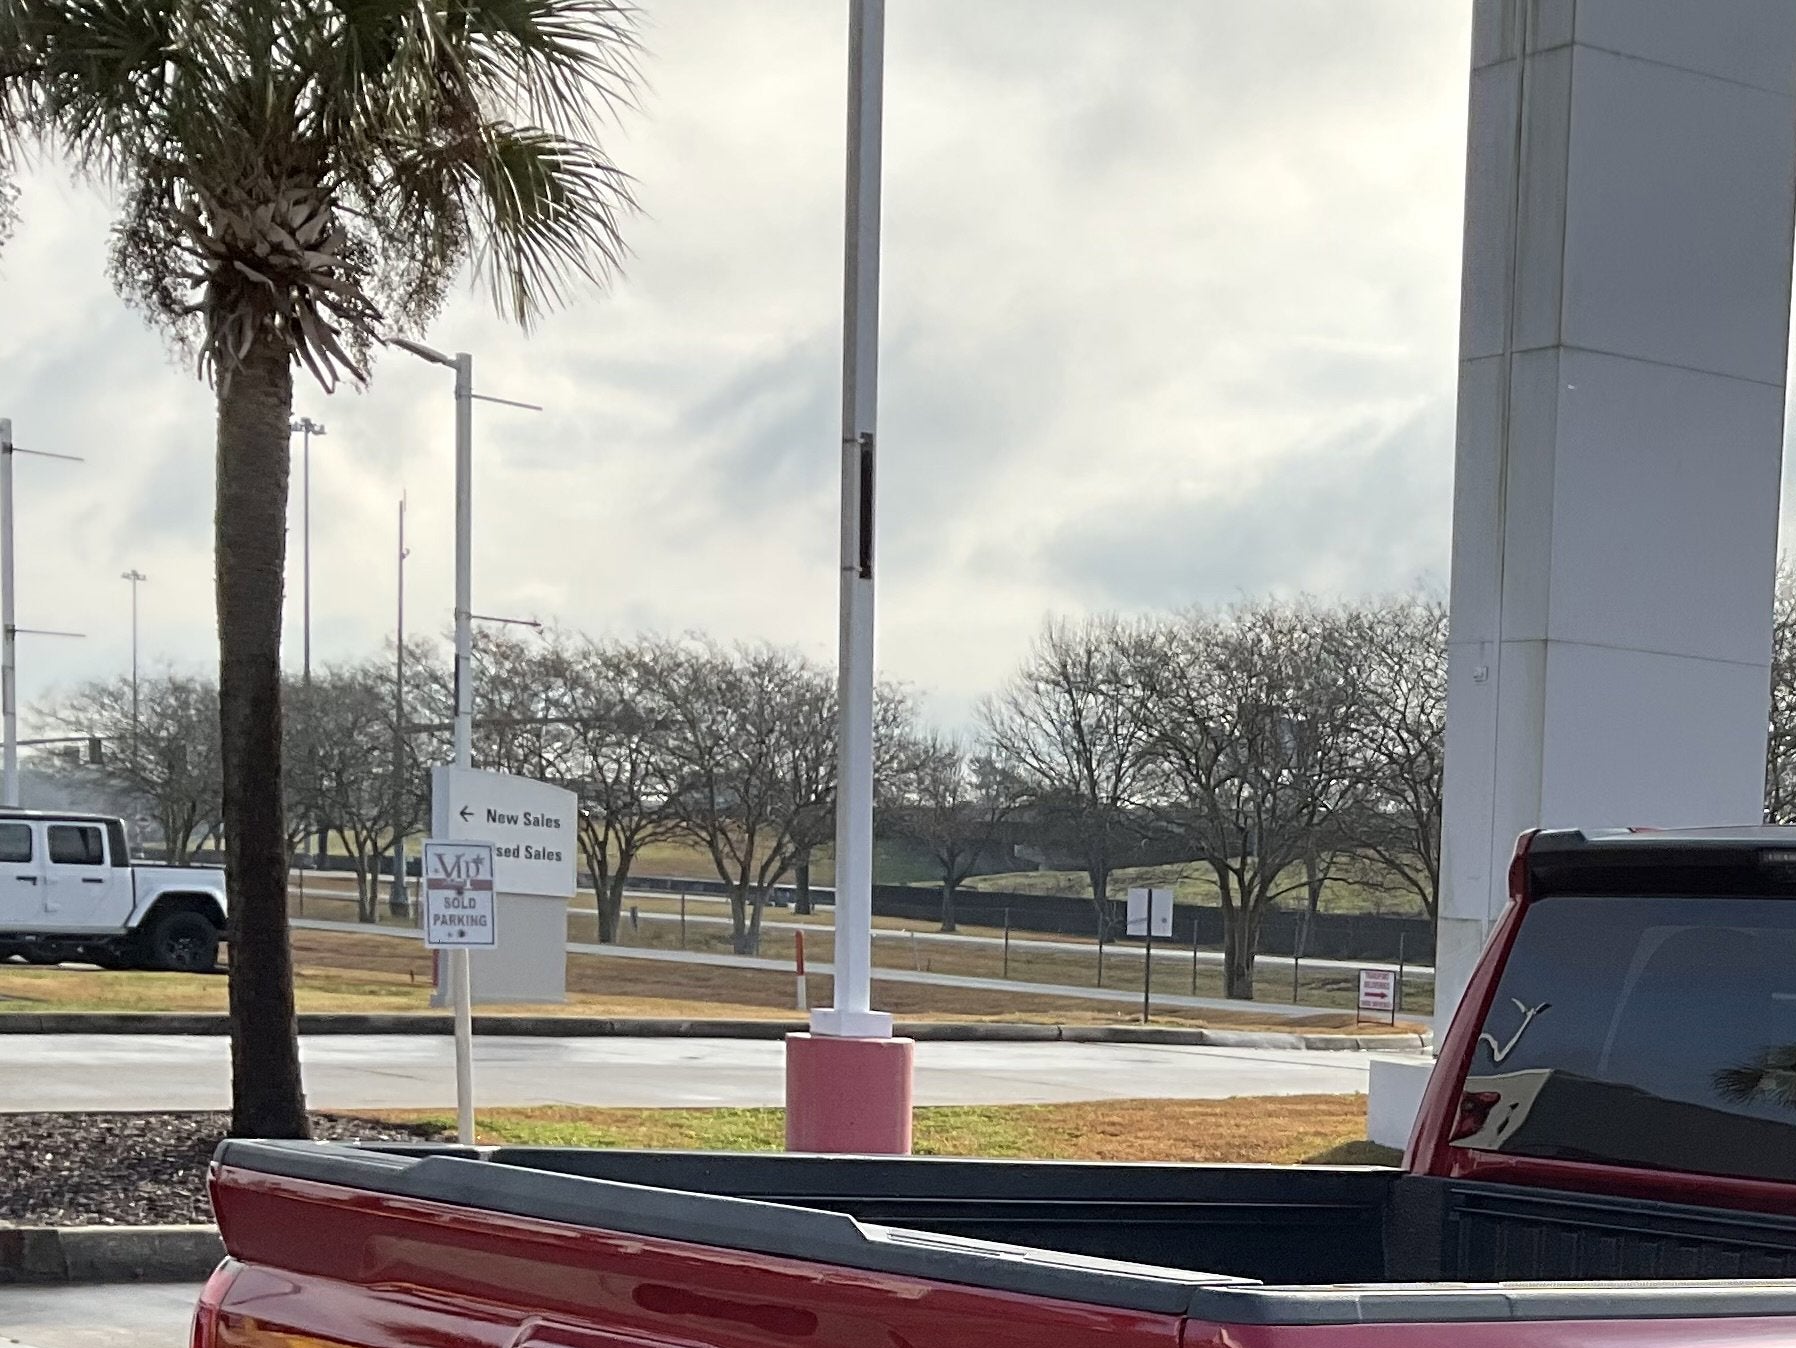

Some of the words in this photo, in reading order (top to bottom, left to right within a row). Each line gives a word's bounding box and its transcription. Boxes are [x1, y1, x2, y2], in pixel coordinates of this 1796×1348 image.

[486, 808, 519, 826] New
[523, 812, 561, 829] Sales
[495, 844, 520, 859] sed
[524, 845, 562, 862] Sales
[443, 896, 476, 909] SOLD
[432, 913, 488, 927] PARKING
